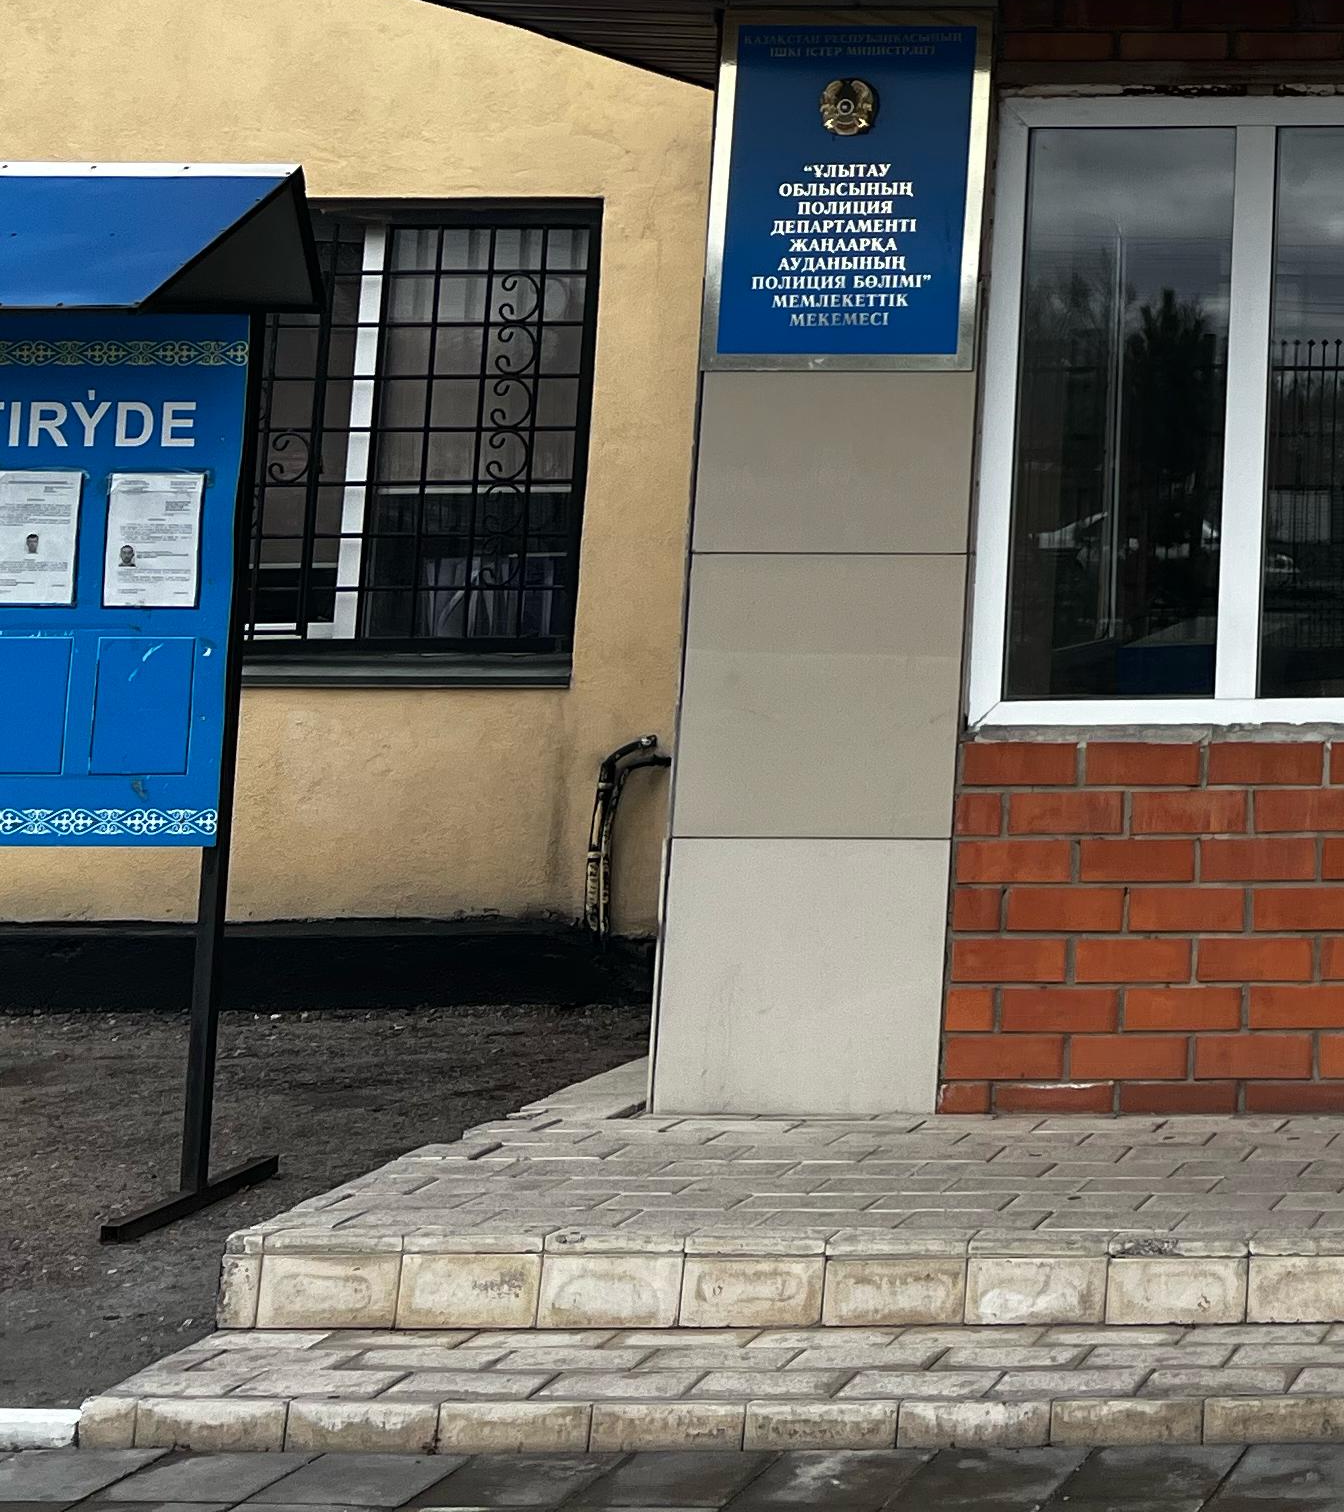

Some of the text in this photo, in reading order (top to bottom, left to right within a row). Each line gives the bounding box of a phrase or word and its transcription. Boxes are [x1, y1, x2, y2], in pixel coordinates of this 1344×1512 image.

[778, 181, 914, 197] ОБЛЫСЫНЫҢ
[797, 200, 893, 216] ПОЛИЦИЯ
[770, 218, 917, 236] ДЕПАРТАМЕНТІ
[789, 237, 898, 253] ЖАҢААРҚА
[777, 255, 906, 272] АУДАНЫНЫҢ
[751, 275, 846, 290] ПОЛИЦИЯ
[771, 293, 909, 309] МЕМЛЕКЕТТІК
[789, 311, 889, 327] МЕКЕМЕСІ
